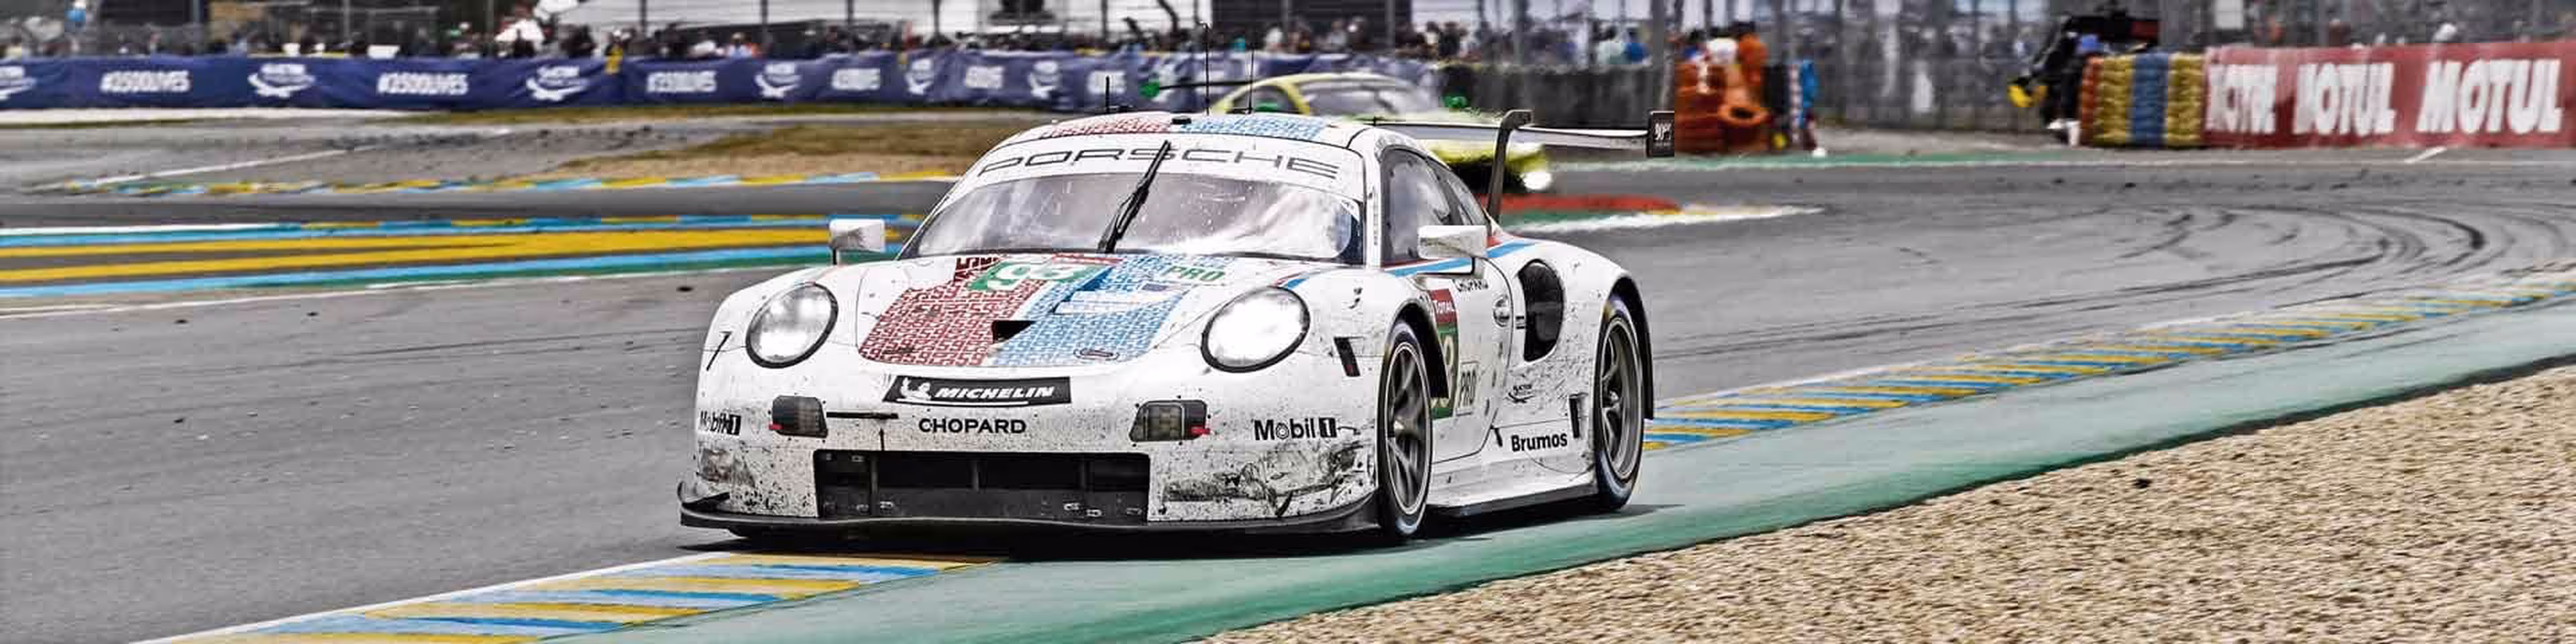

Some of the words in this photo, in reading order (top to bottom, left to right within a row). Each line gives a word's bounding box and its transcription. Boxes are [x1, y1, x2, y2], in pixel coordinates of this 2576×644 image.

[2417, 58, 2564, 134] MOTUL
[978, 147, 1340, 180] PORSCHE
[1160, 265, 1226, 282] PRO
[934, 386, 1055, 399] MICHELIN
[1457, 368, 1477, 407] PRO
[918, 418, 1027, 434] CHOPARD
[1253, 418, 1316, 440] Mobil
[1511, 433, 1568, 452] Brumos
